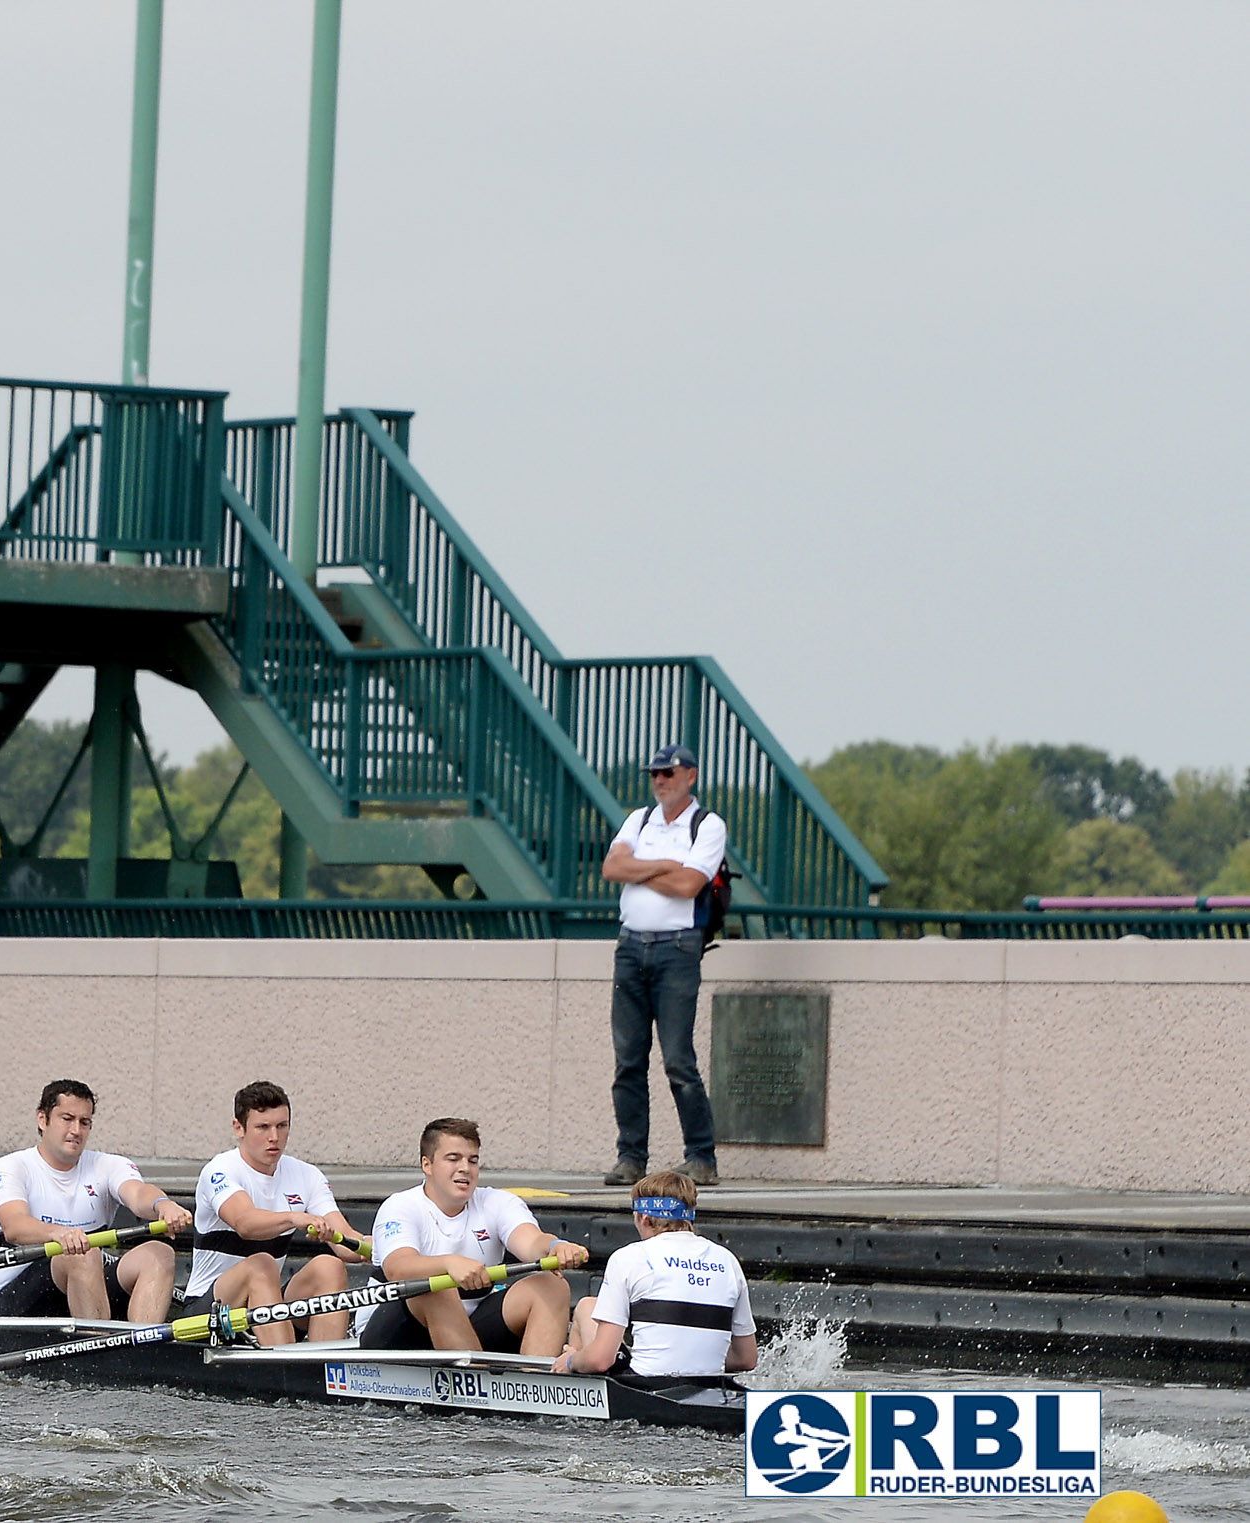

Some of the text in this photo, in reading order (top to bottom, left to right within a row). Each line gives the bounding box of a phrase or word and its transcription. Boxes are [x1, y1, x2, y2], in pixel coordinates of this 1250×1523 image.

[664, 1256, 725, 1273] Waldsee
[688, 1273, 711, 1287] 8er
[308, 1283, 399, 1314] FRANKE
[25, 1328, 163, 1361] STARK. SCHNELL. GUT. RBL
[348, 1364, 381, 1378] Volksbank
[350, 1379, 432, 1398] Allgäu-Oberschwaben eG
[452, 1372, 488, 1398] RBL
[492, 1381, 605, 1408] RUDER-BUNDESLIGA
